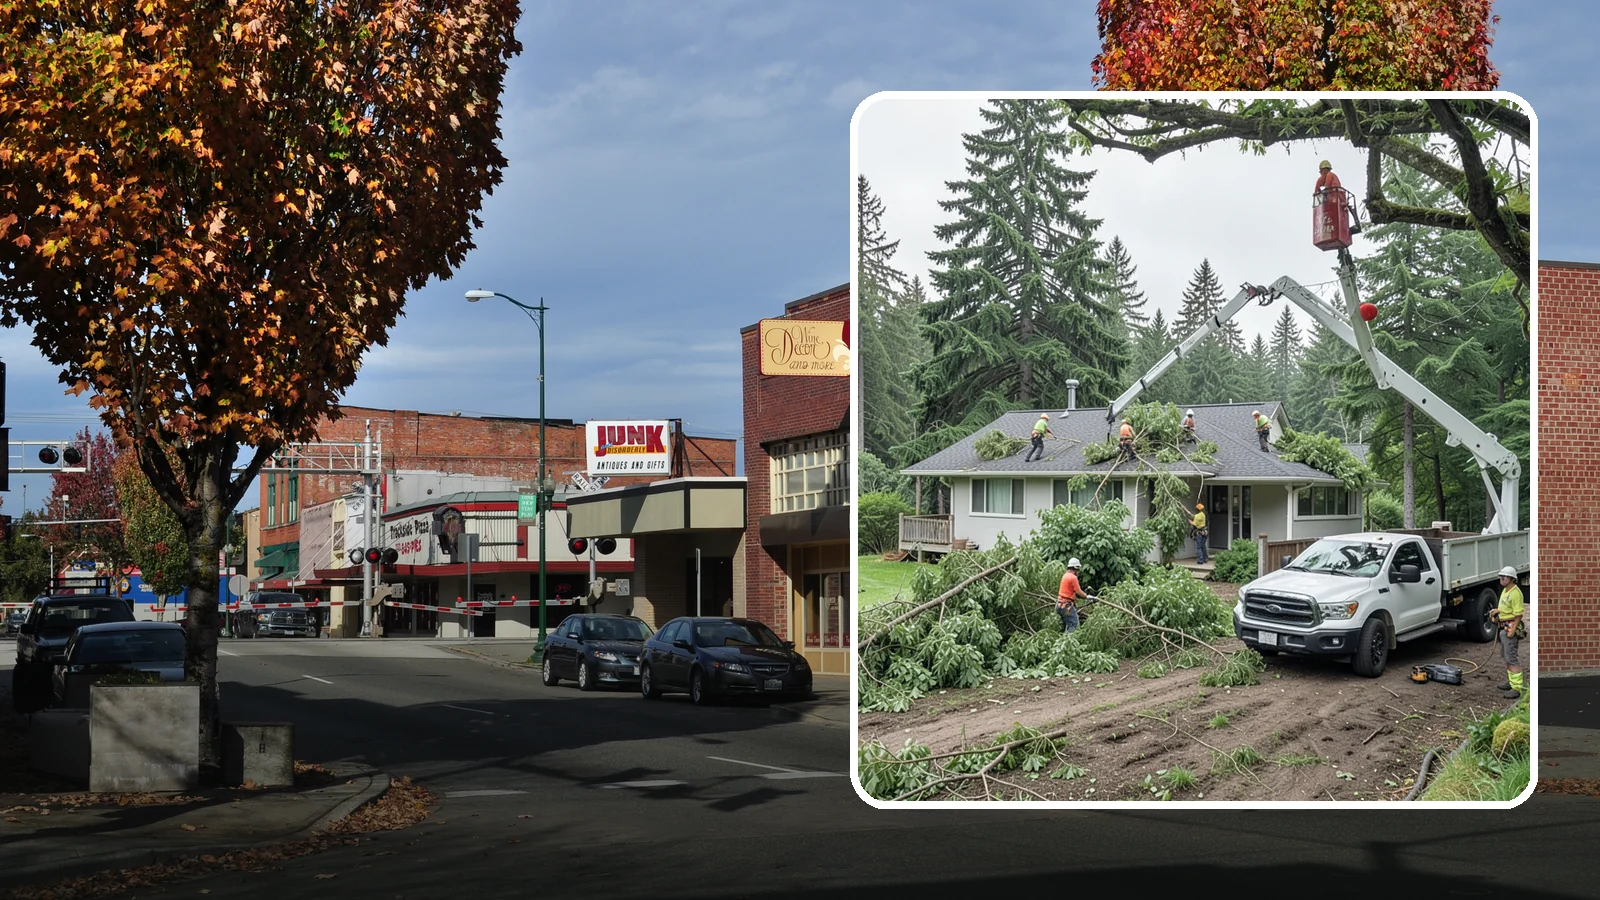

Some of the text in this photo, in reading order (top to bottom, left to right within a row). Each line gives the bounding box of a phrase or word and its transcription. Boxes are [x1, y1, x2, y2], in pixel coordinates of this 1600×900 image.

[595, 425, 665, 457] JUNK
[597, 460, 665, 470] ANTIQUES AND GIFTS
[390, 519, 429, 540] Trackside Pizza
